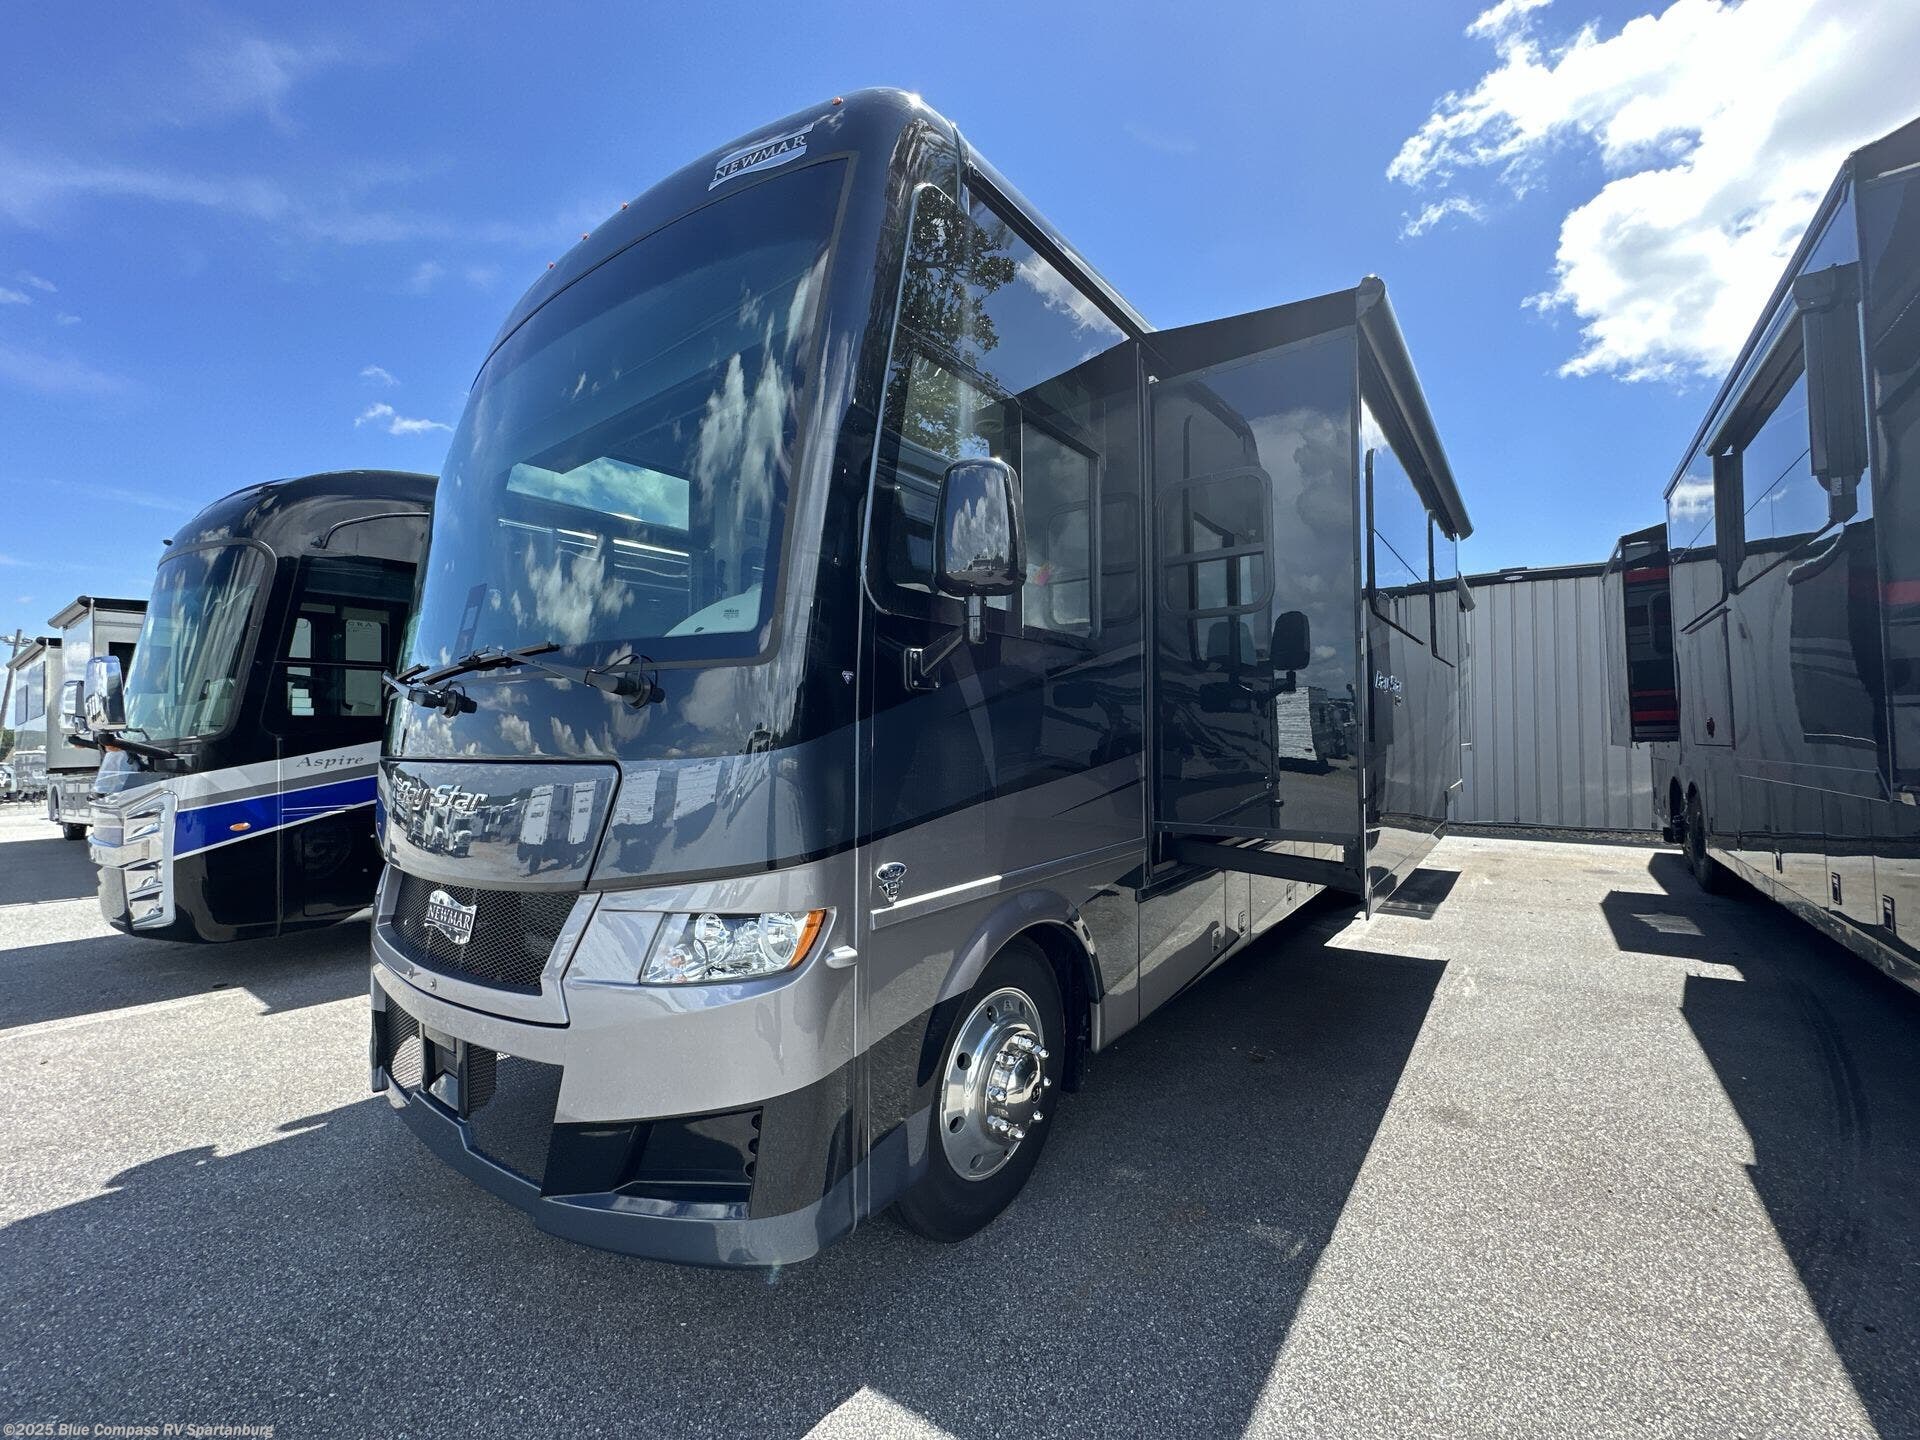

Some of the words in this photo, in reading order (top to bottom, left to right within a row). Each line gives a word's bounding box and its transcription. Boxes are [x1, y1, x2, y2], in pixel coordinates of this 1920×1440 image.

[712, 135, 807, 181] NEWMAR
[296, 755, 365, 769] Aspire
[429, 783, 489, 813] Star
[426, 903, 471, 931] NEWMAR
